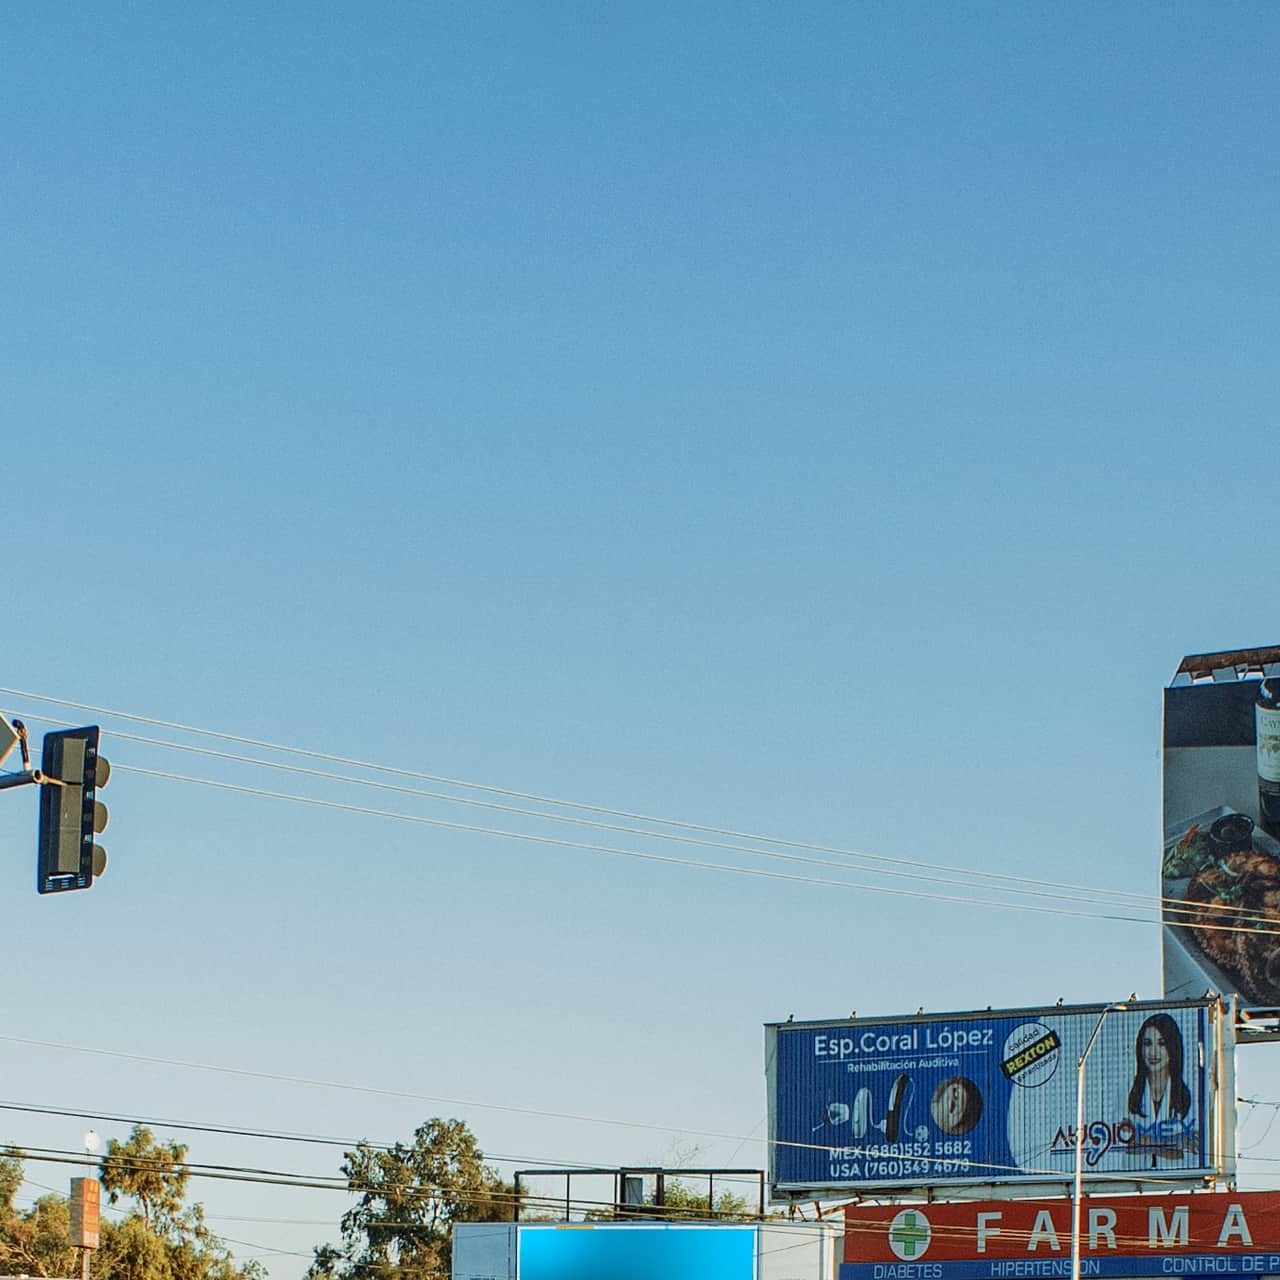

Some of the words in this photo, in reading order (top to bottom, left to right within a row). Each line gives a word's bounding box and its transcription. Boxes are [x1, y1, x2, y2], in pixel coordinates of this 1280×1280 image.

[926, 1027, 993, 1052] López
[848, 1058, 917, 1073] Rehabilitación
[918, 1057, 960, 1069] Auditiva
[1007, 1036, 1055, 1074] REXTON
[829, 1146, 862, 1161] MEX
[866, 1142, 931, 1160] (686)552
[935, 1141, 972, 1155] 5682
[830, 1163, 861, 1177] USA
[864, 1160, 929, 1177] (760)349
[874, 1264, 943, 1280] DIABETES
[990, 1259, 1100, 1277] HIPERTENSON
[1162, 1257, 1237, 1274] CONTROL
[1242, 1256, 1264, 1272] DE
